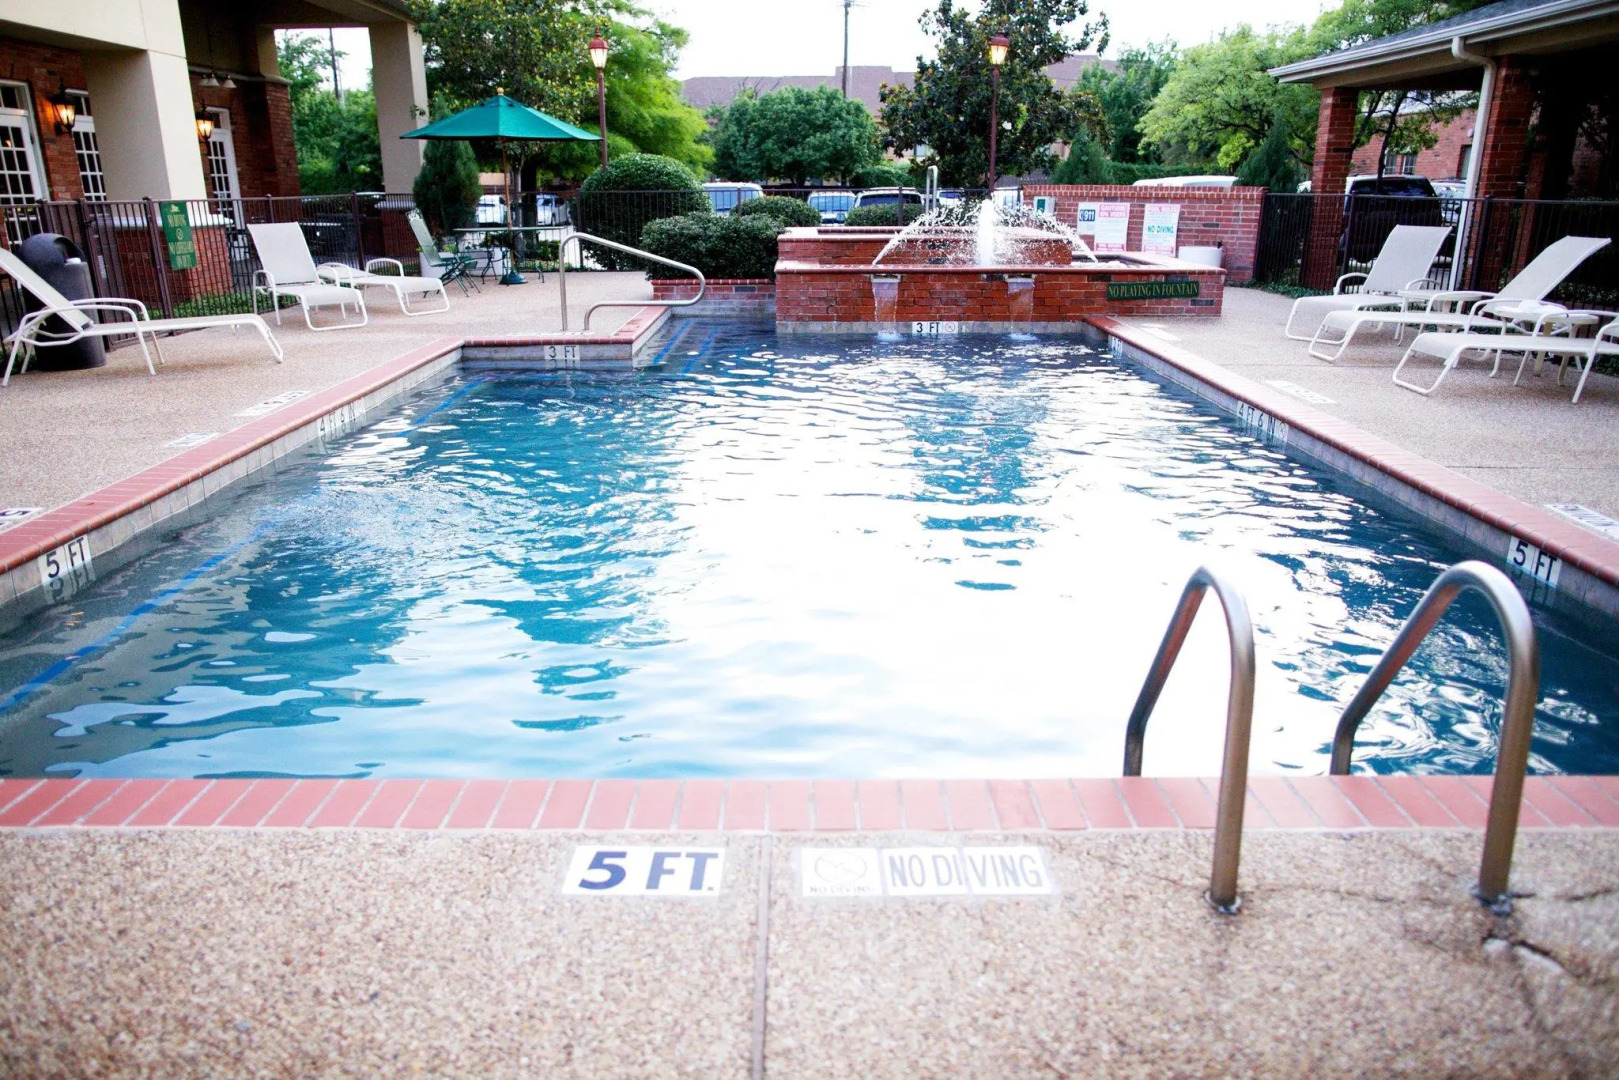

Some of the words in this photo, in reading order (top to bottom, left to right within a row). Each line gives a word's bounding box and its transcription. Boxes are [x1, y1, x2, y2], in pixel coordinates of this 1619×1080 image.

[1084, 210, 1095, 220] 911
[1147, 225, 1155, 233] NO
[1157, 225, 1174, 233] DIVING
[1108, 285, 1119, 297] NO
[1120, 284, 1152, 297] PLAYING
[1153, 284, 1160, 295] IN
[1162, 283, 1198, 296] FOUNTAIN
[917, 322, 923, 333] 3
[929, 321, 940, 333] FT
[549, 345, 557, 358] 3
[564, 345, 577, 358] FT
[1257, 412, 1264, 428] 6
[46, 551, 60, 579] 5
[67, 537, 85, 567] FT
[1513, 540, 1529, 567] 5
[1535, 549, 1558, 582] FT
[578, 851, 628, 891] 5
[889, 854, 925, 888] NO
[932, 853, 1043, 888] DIVING
[809, 885, 827, 894] NO
